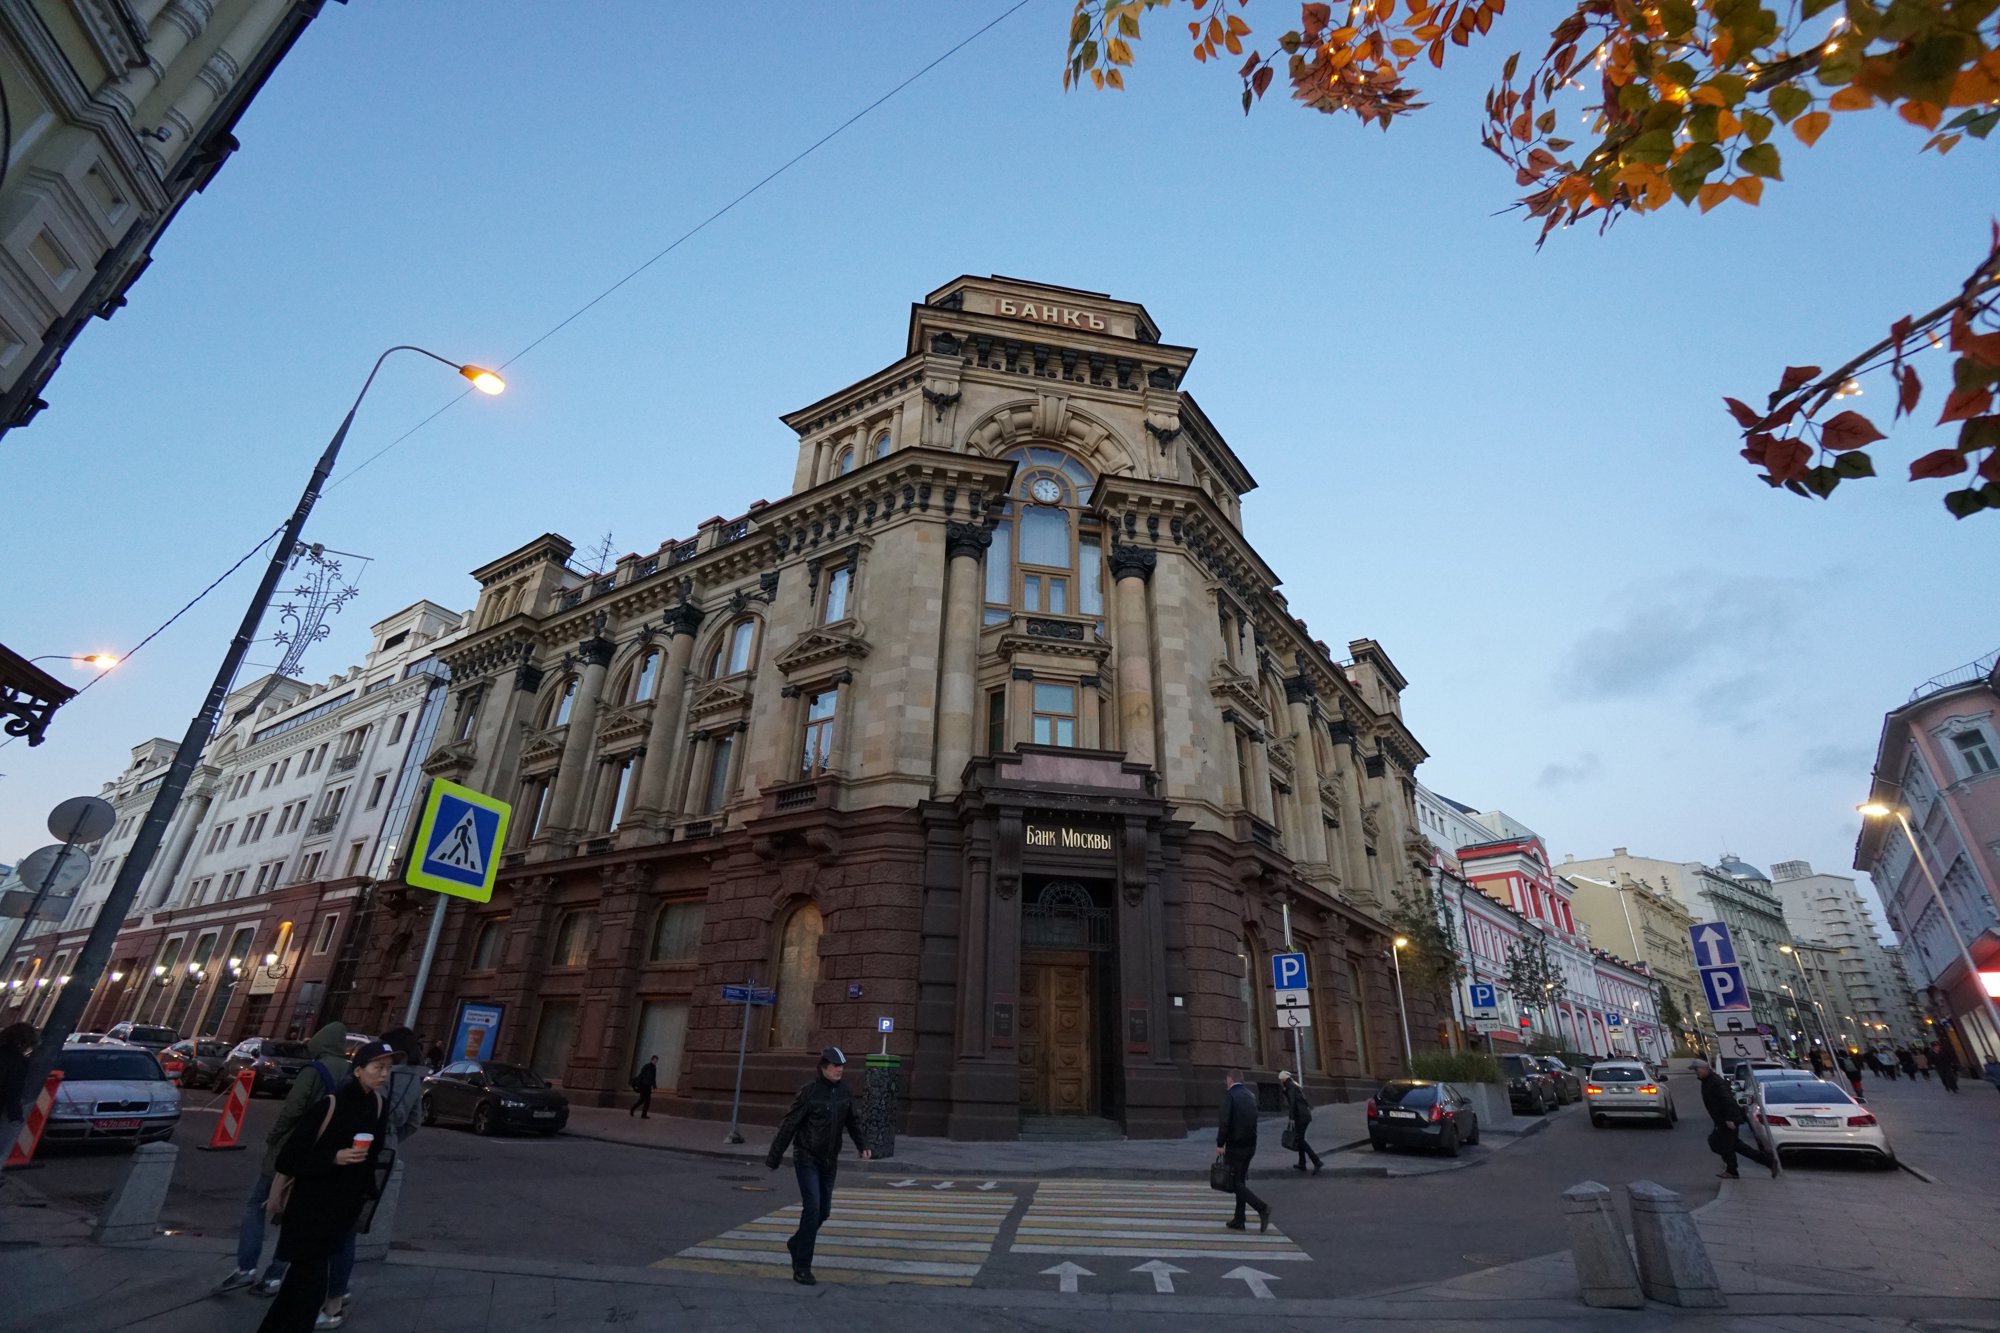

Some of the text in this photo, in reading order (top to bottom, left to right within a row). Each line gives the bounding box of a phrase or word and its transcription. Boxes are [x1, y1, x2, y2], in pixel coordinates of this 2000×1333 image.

[1000, 298, 1105, 331] БАНКЪ
[1026, 825, 1111, 850] Банк Москвы
[1281, 958, 1300, 986] P
[1475, 987, 1491, 1006] P
[1711, 971, 1734, 1007] P
[882, 1019, 890, 1030] P
[1609, 1014, 1618, 1026] P
